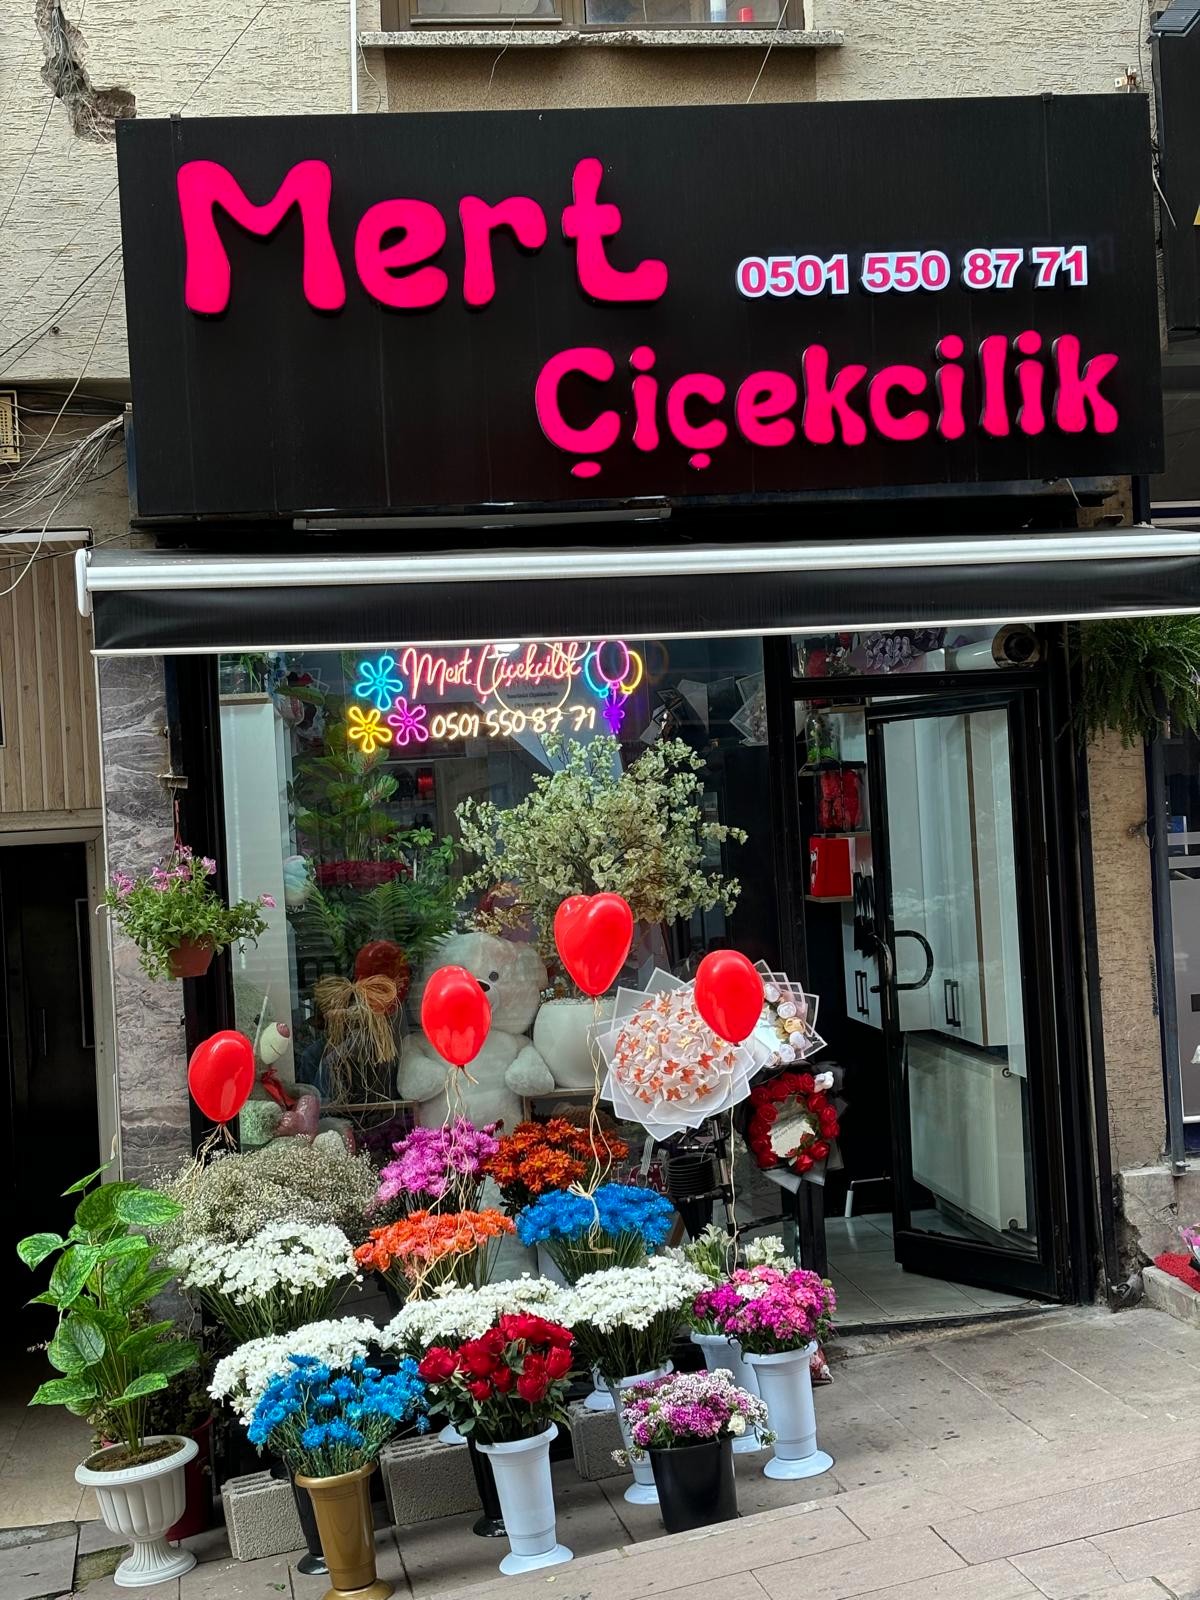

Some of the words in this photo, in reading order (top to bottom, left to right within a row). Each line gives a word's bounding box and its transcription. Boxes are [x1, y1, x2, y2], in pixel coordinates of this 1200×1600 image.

[176, 157, 669, 316] Mert
[736, 253, 850, 298] 0501
[860, 250, 951, 294] 550
[962, 248, 1024, 290] 87
[1030, 245, 1089, 288] 71
[534, 329, 1120, 479] Çiçekcilik
[402, 647, 473, 699] Mert
[430, 712, 479, 741] 0501
[485, 708, 527, 738] 550
[532, 708, 564, 734] 87
[569, 705, 597, 731] 71
